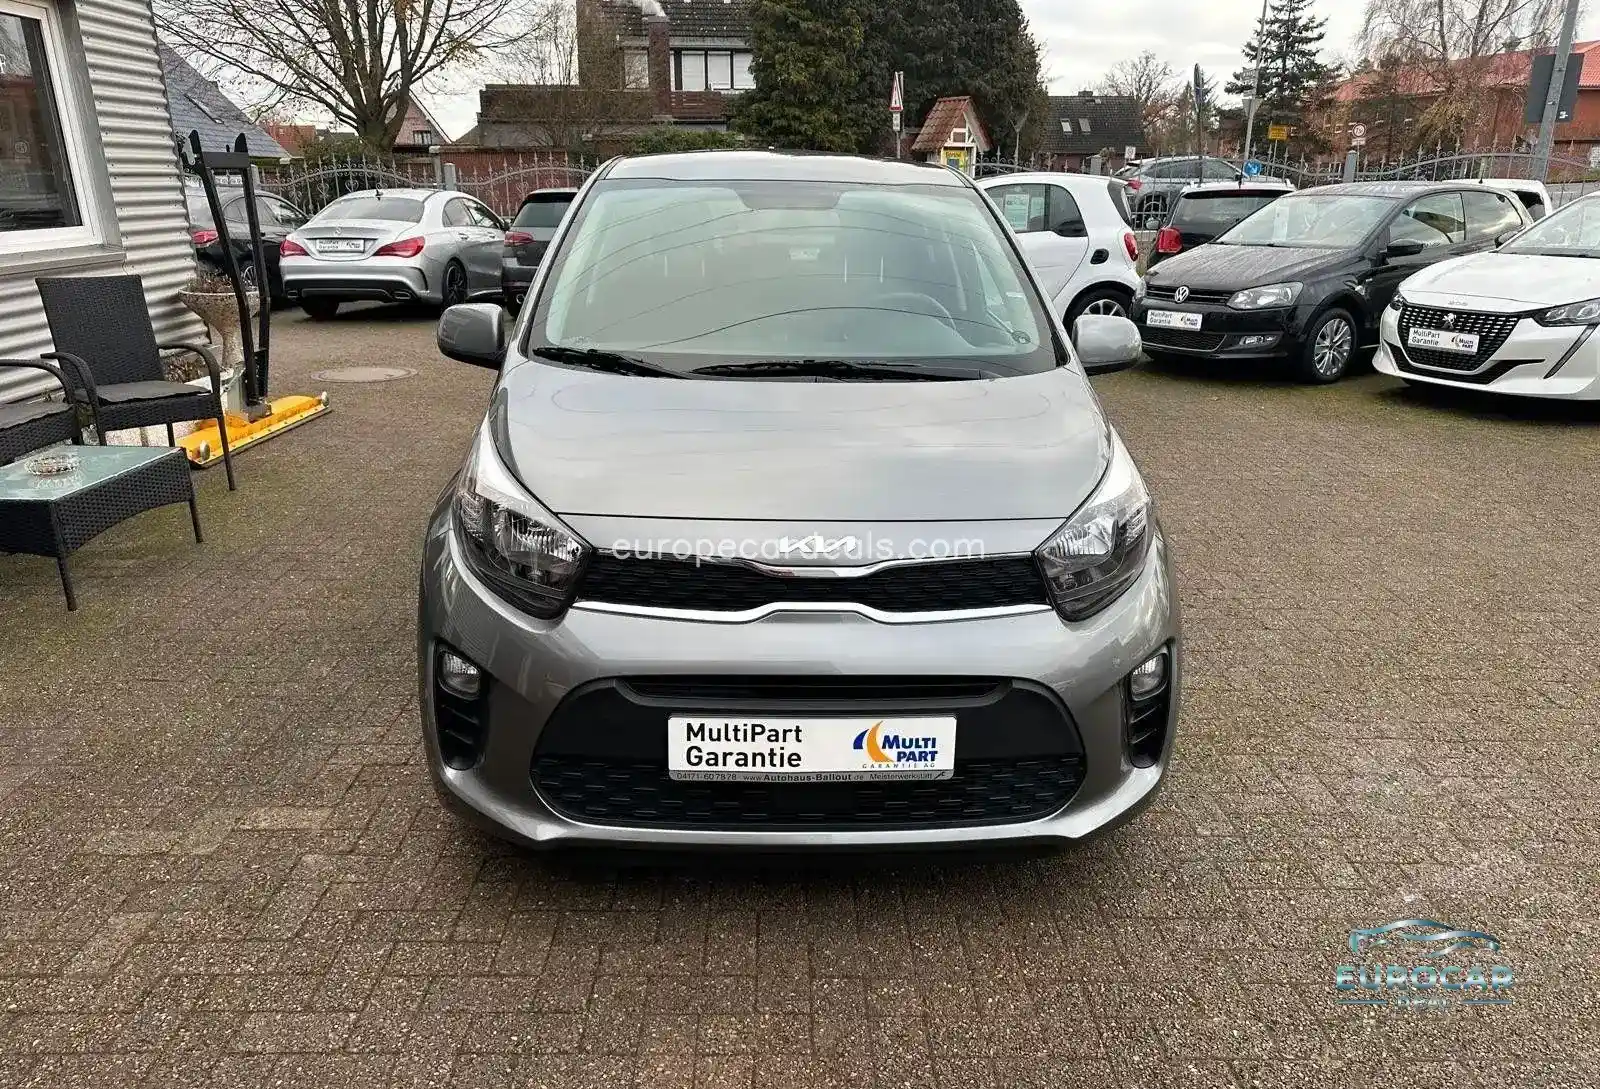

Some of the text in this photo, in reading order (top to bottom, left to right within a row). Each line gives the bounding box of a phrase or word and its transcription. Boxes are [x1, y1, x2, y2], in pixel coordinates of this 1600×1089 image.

[1412, 336, 1439, 346] Garantie
[1413, 329, 1440, 339] MultiPart
[686, 722, 803, 743] MultiPart
[881, 734, 937, 750] MULTI
[686, 745, 802, 768] Garantie
[896, 750, 939, 763] PART
